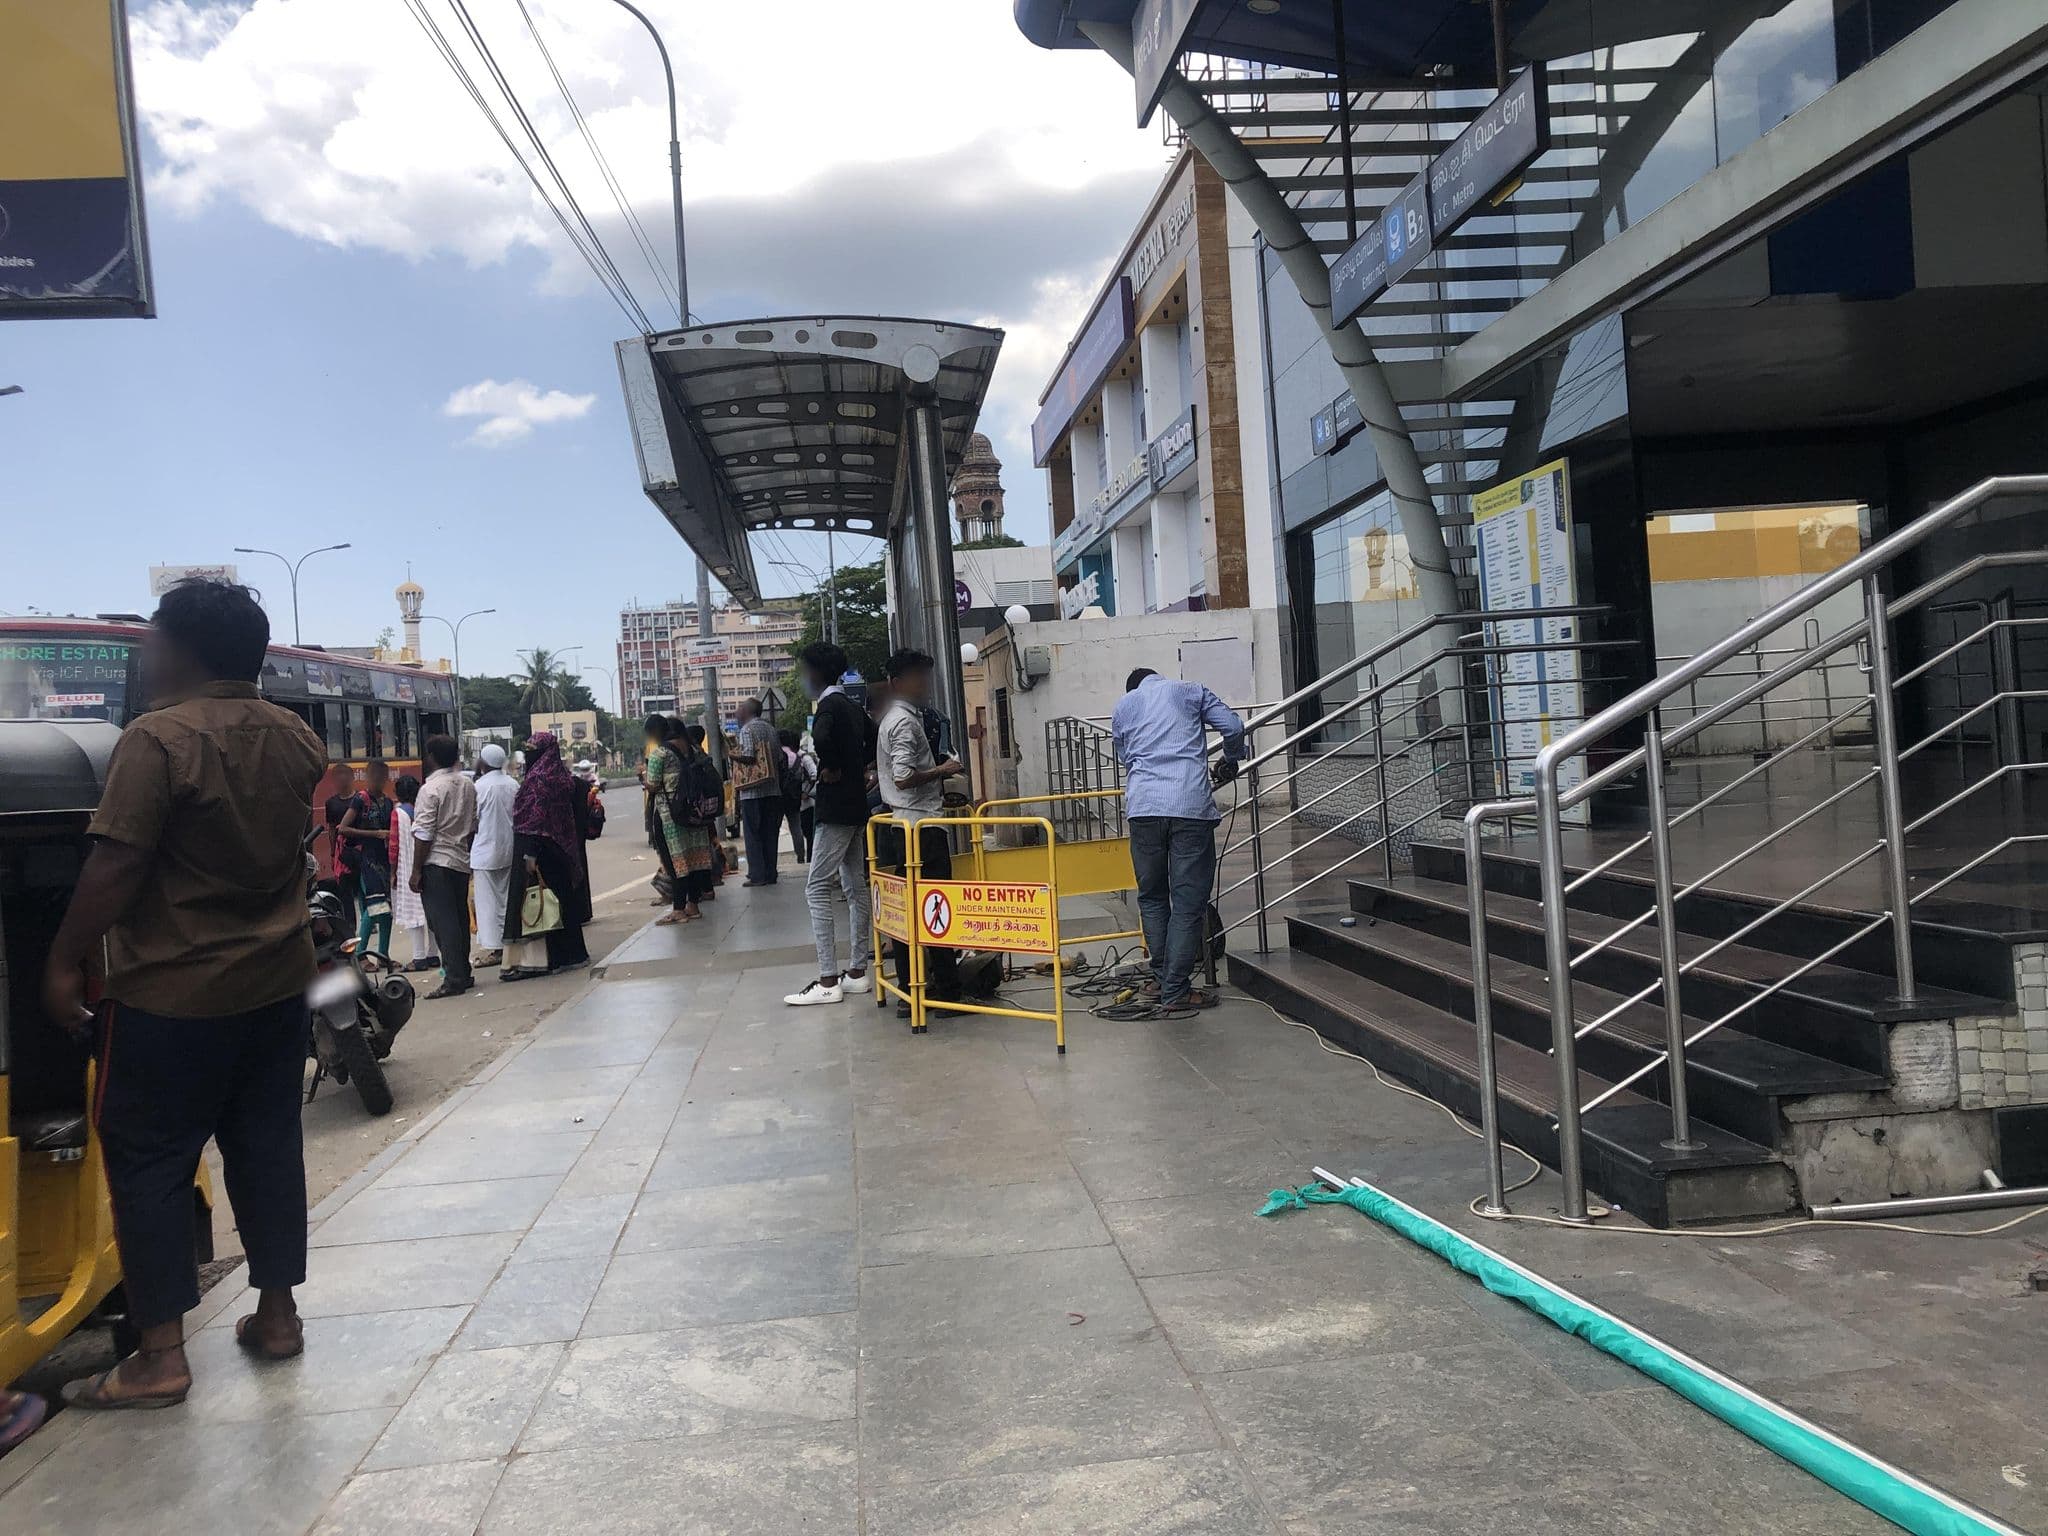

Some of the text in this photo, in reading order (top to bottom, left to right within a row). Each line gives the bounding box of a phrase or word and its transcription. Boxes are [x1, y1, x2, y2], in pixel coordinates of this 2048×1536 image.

[1475, 91, 1526, 151] மெட்ரோ
[1453, 182, 1475, 210] Metro
[0, 646, 56, 660] HORE
[48, 695, 102, 703] DELUXE
[963, 888, 1036, 903] NO ENTRY
[956, 905, 1047, 916] UNDER MAINTENANCE
[1003, 919, 1040, 933] இல்லை
